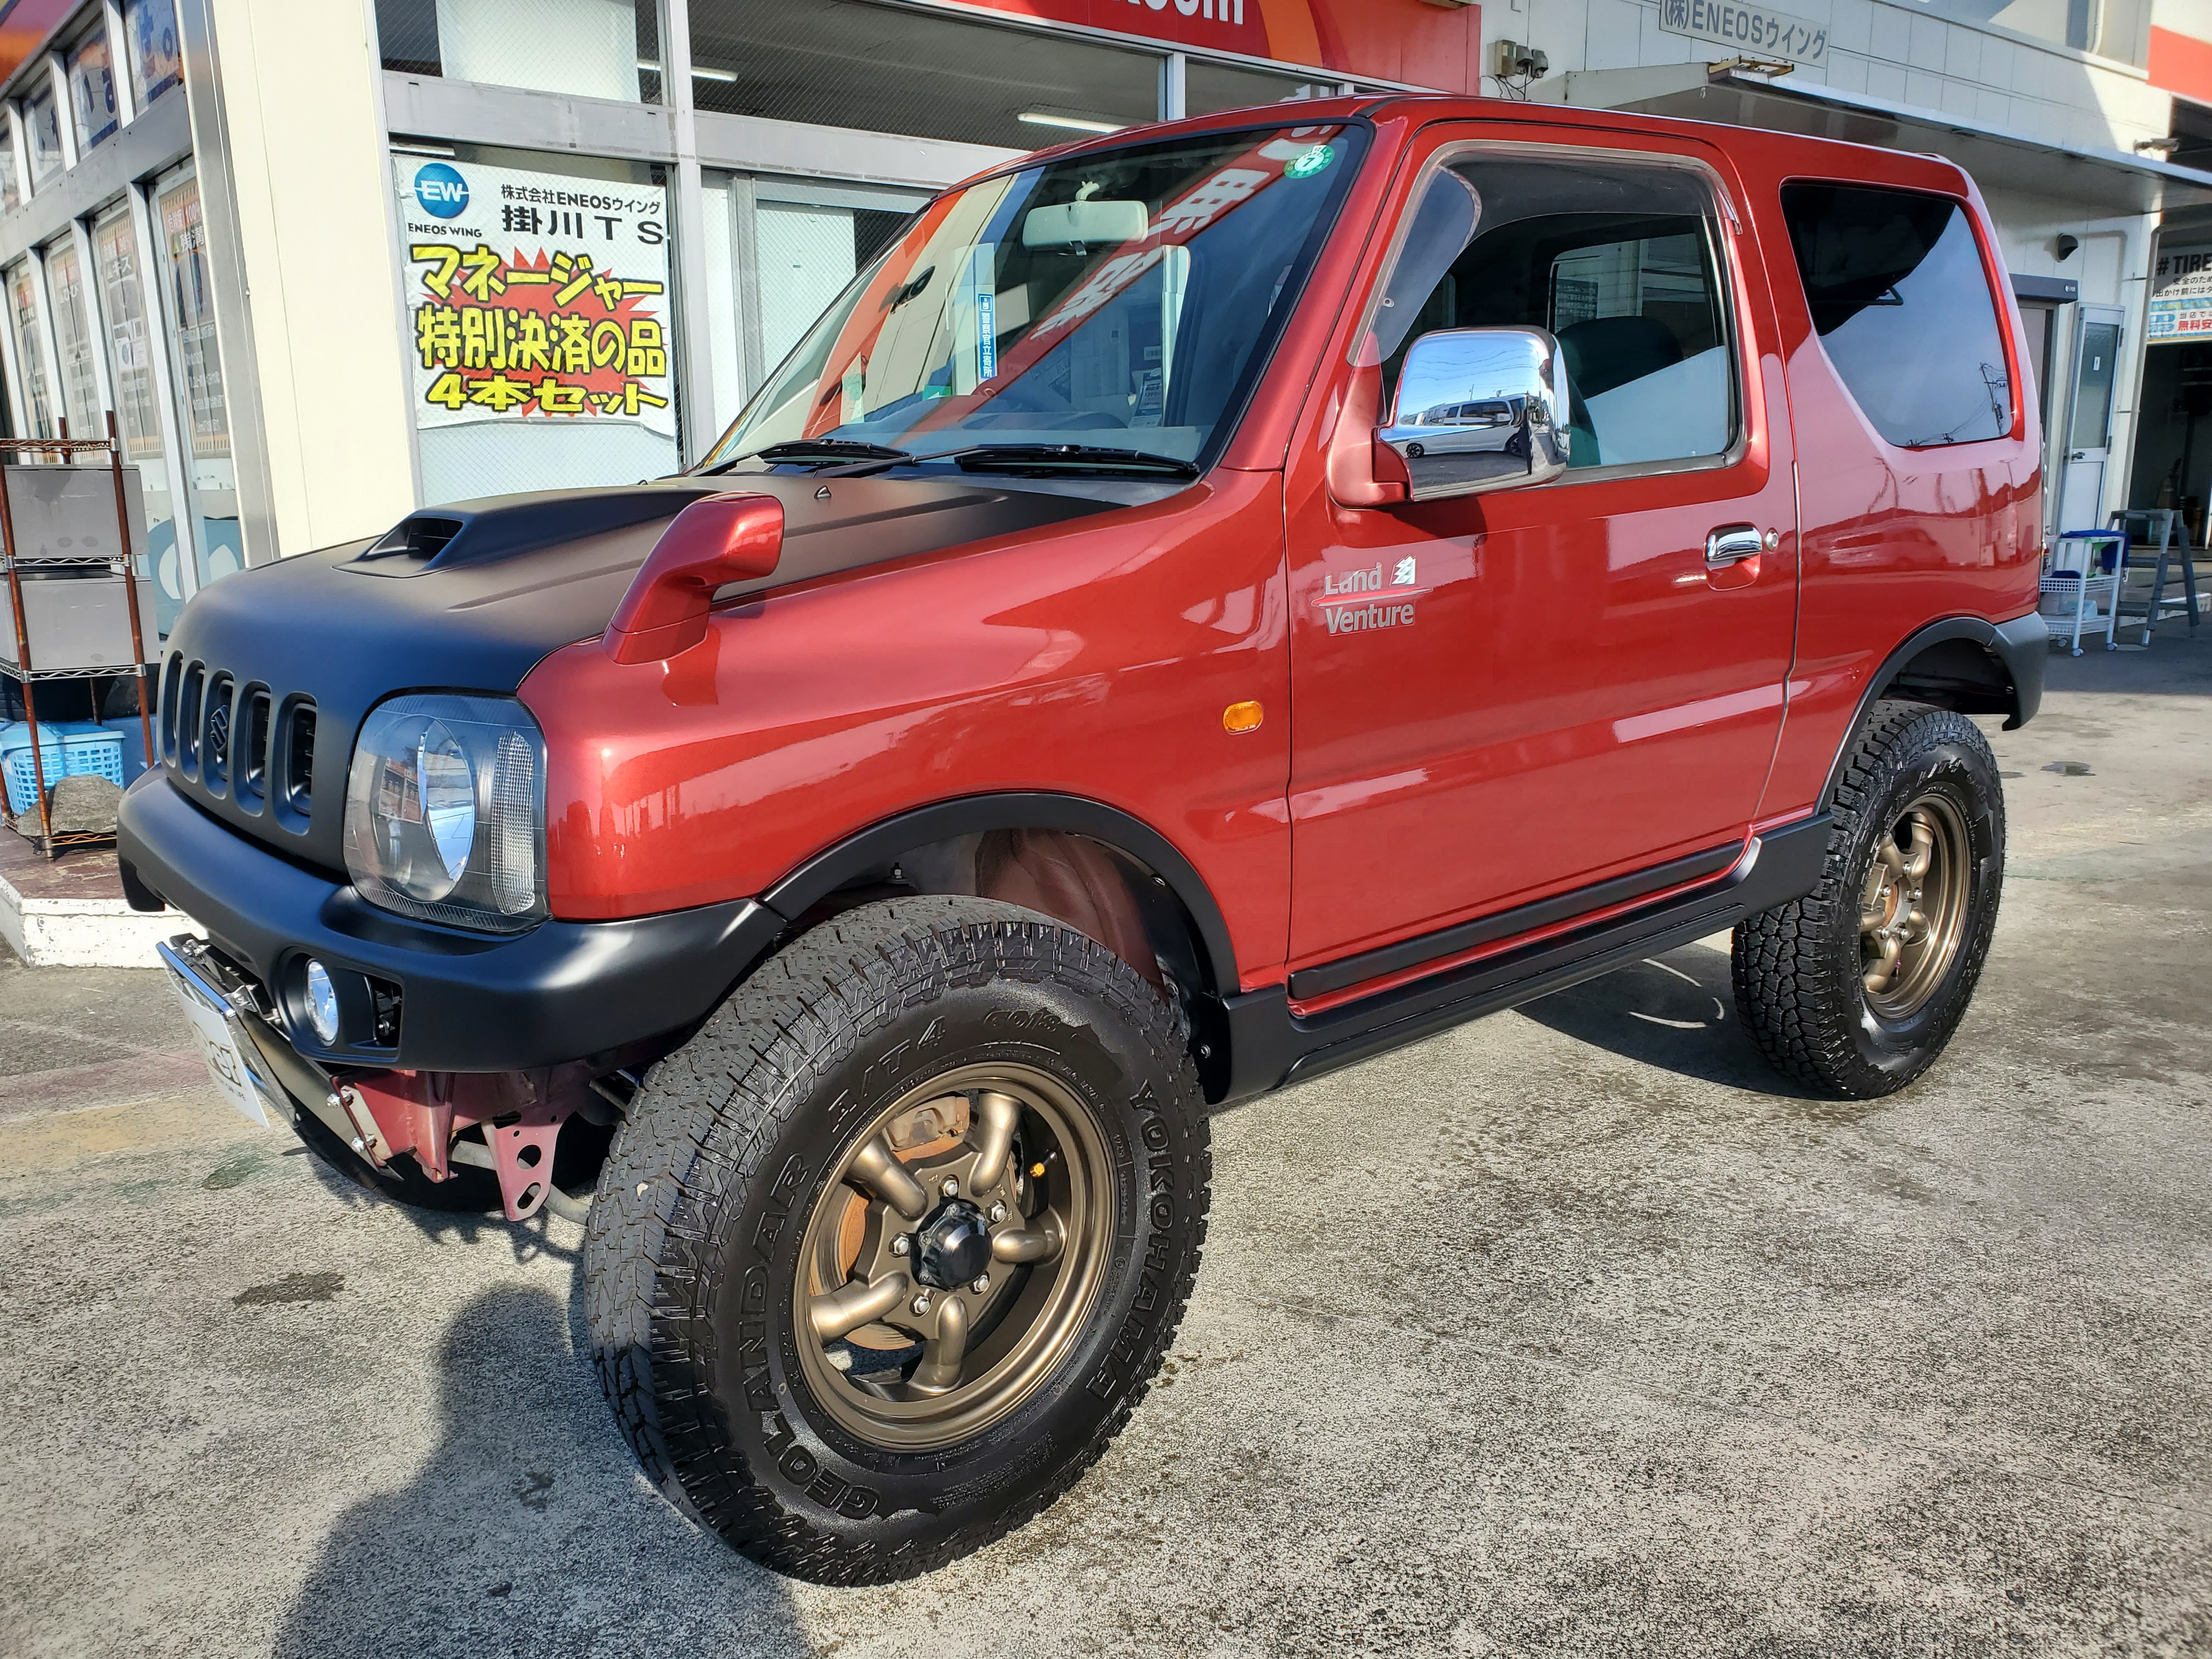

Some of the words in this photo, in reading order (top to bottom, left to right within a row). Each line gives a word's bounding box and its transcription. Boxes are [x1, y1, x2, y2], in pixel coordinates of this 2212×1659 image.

[1302, 157, 1316, 167] 7
[420, 180, 463, 203] EW
[501, 184, 661, 215] 株式会社ENEOSウイング
[408, 222, 447, 235] ENEOS
[449, 227, 482, 238] WING
[411, 244, 664, 311] マネージャー
[2152, 285, 2212, 297] 出かけ前にはタ
[415, 304, 667, 377] 特別決済の品
[981, 312, 992, 377] 警察官立寄所
[426, 373, 668, 416] 4本セット
[1325, 562, 1382, 595] Land
[1325, 604, 1414, 634] Venture
[1086, 1079, 1175, 1399] YOKOHAMA
[738, 1153, 880, 1520] GEOLANDAR
